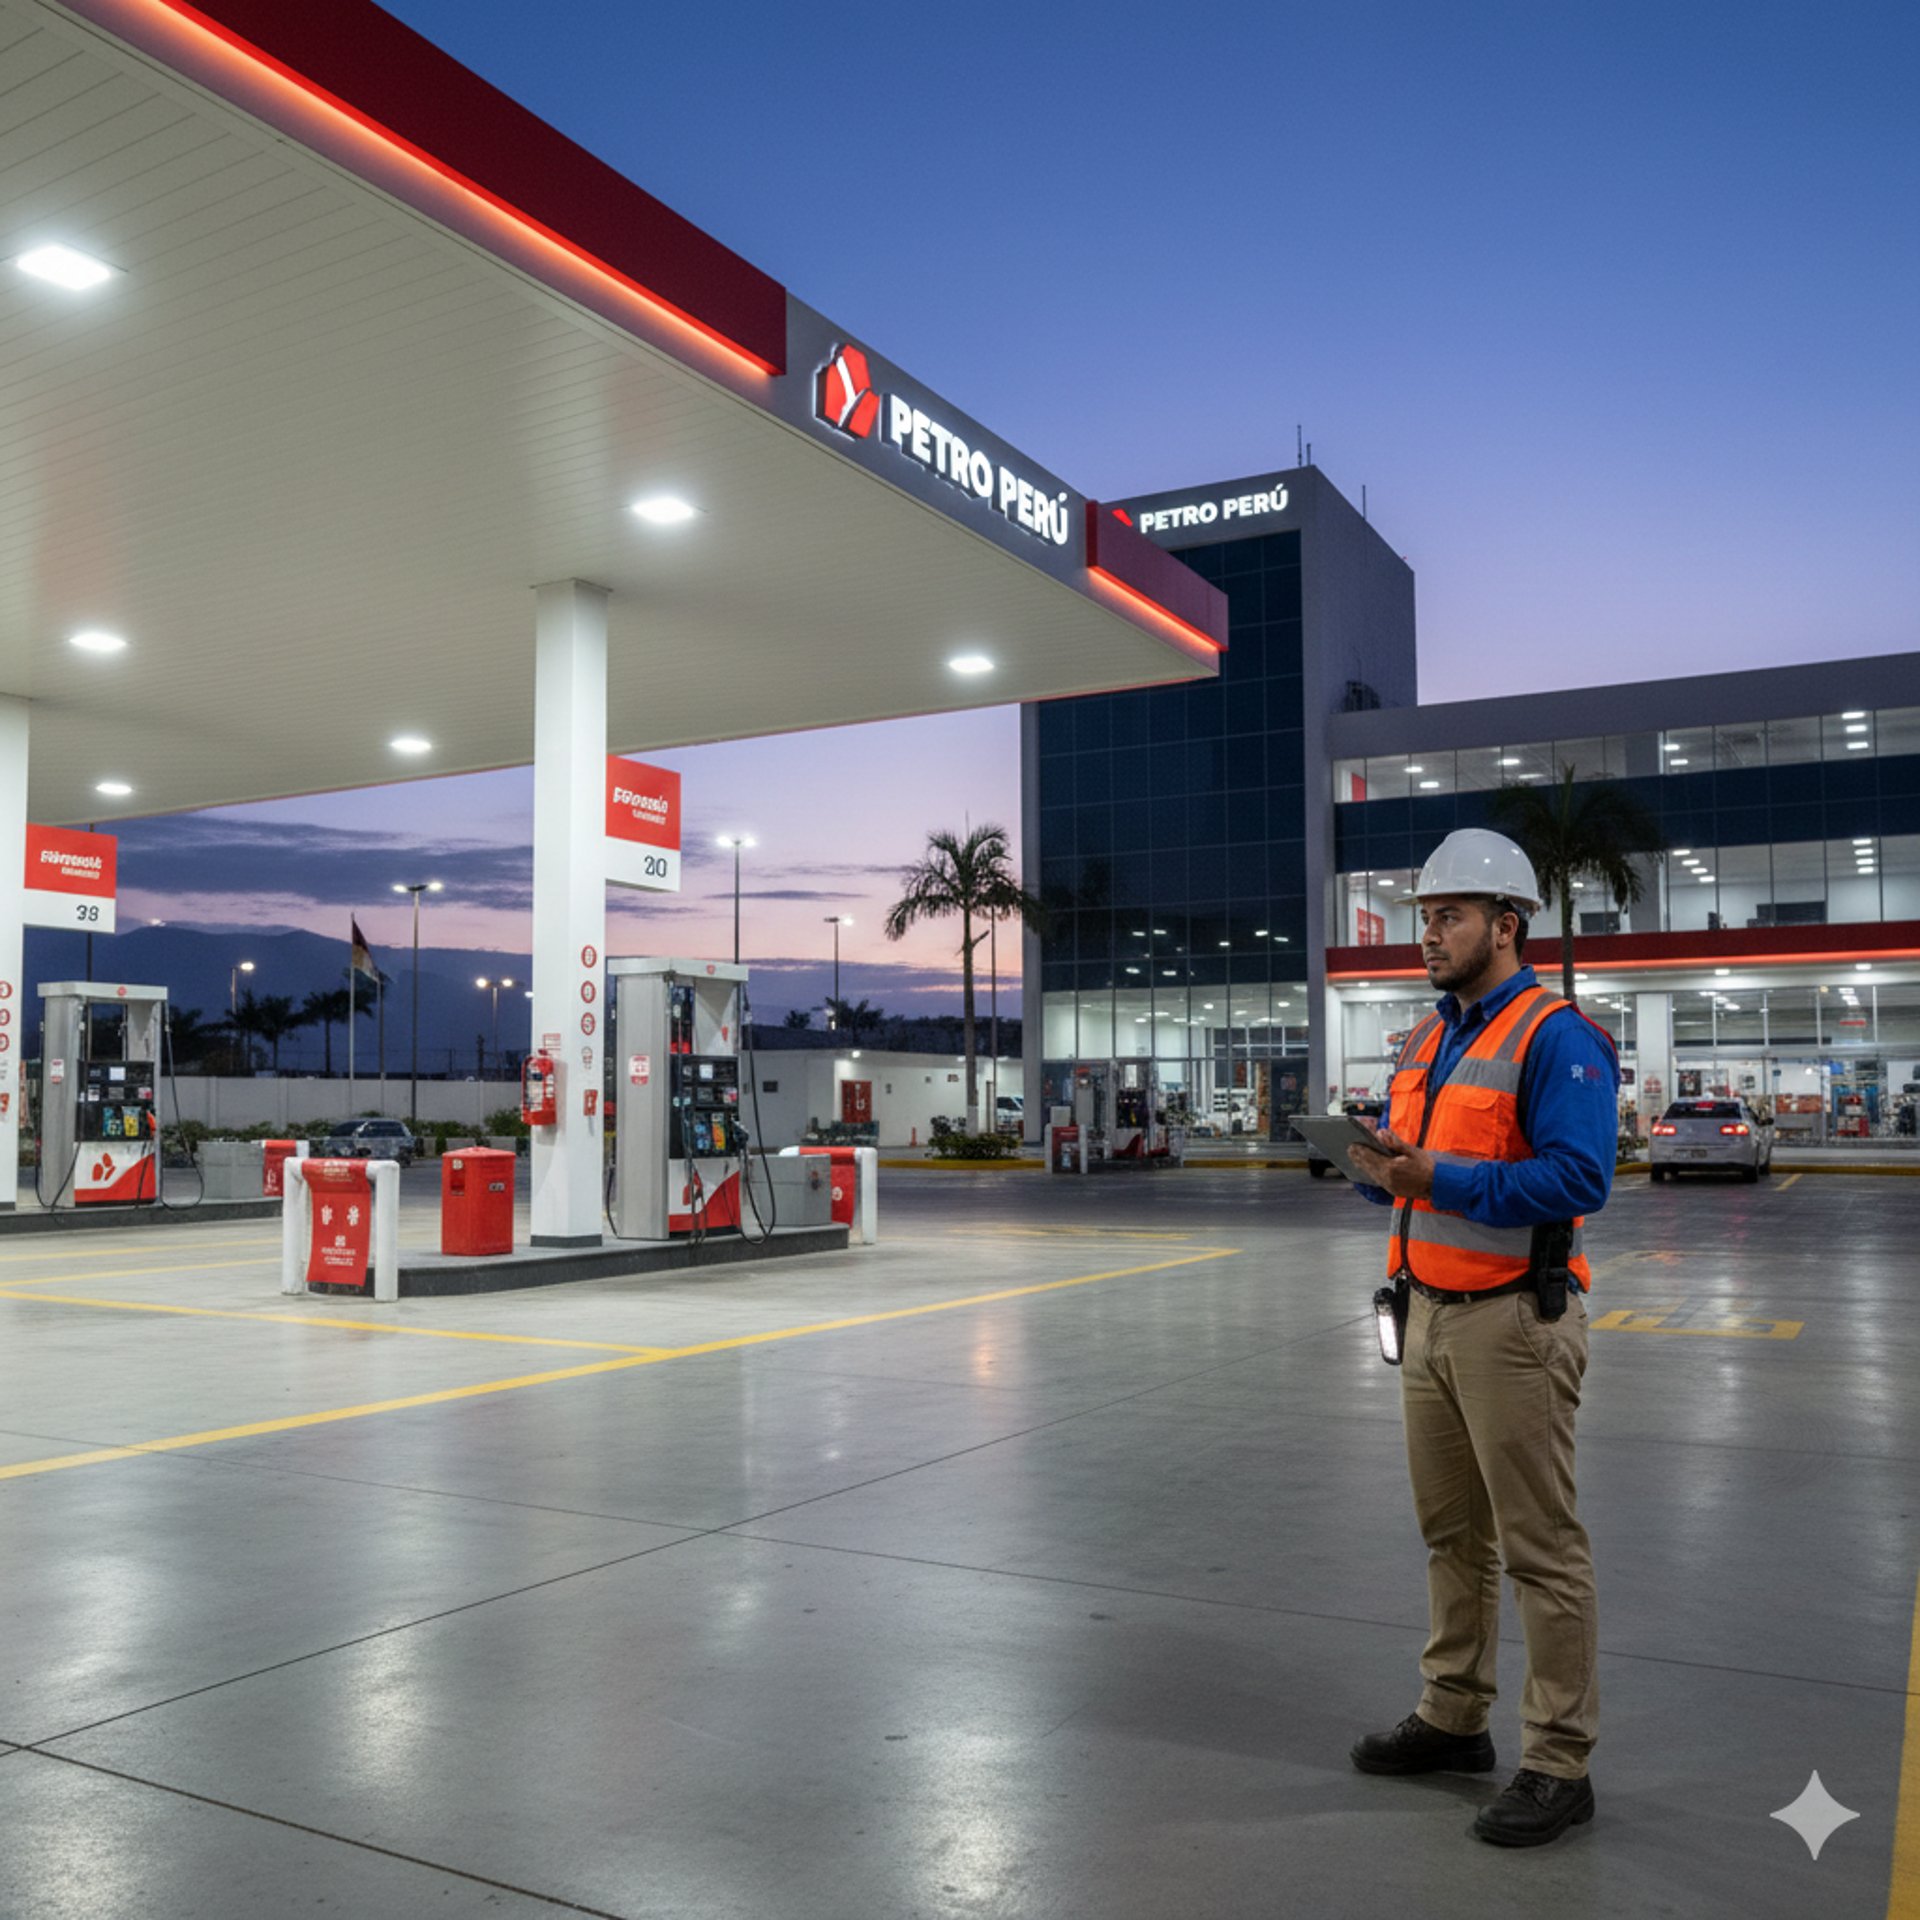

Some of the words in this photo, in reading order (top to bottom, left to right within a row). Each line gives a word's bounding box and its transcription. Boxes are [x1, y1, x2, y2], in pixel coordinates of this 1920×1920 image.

[890, 394, 993, 498] PETRO
[1000, 466, 1068, 545] PERÚ
[1139, 501, 1218, 534] PETRO
[1222, 482, 1288, 520] PERÚ
